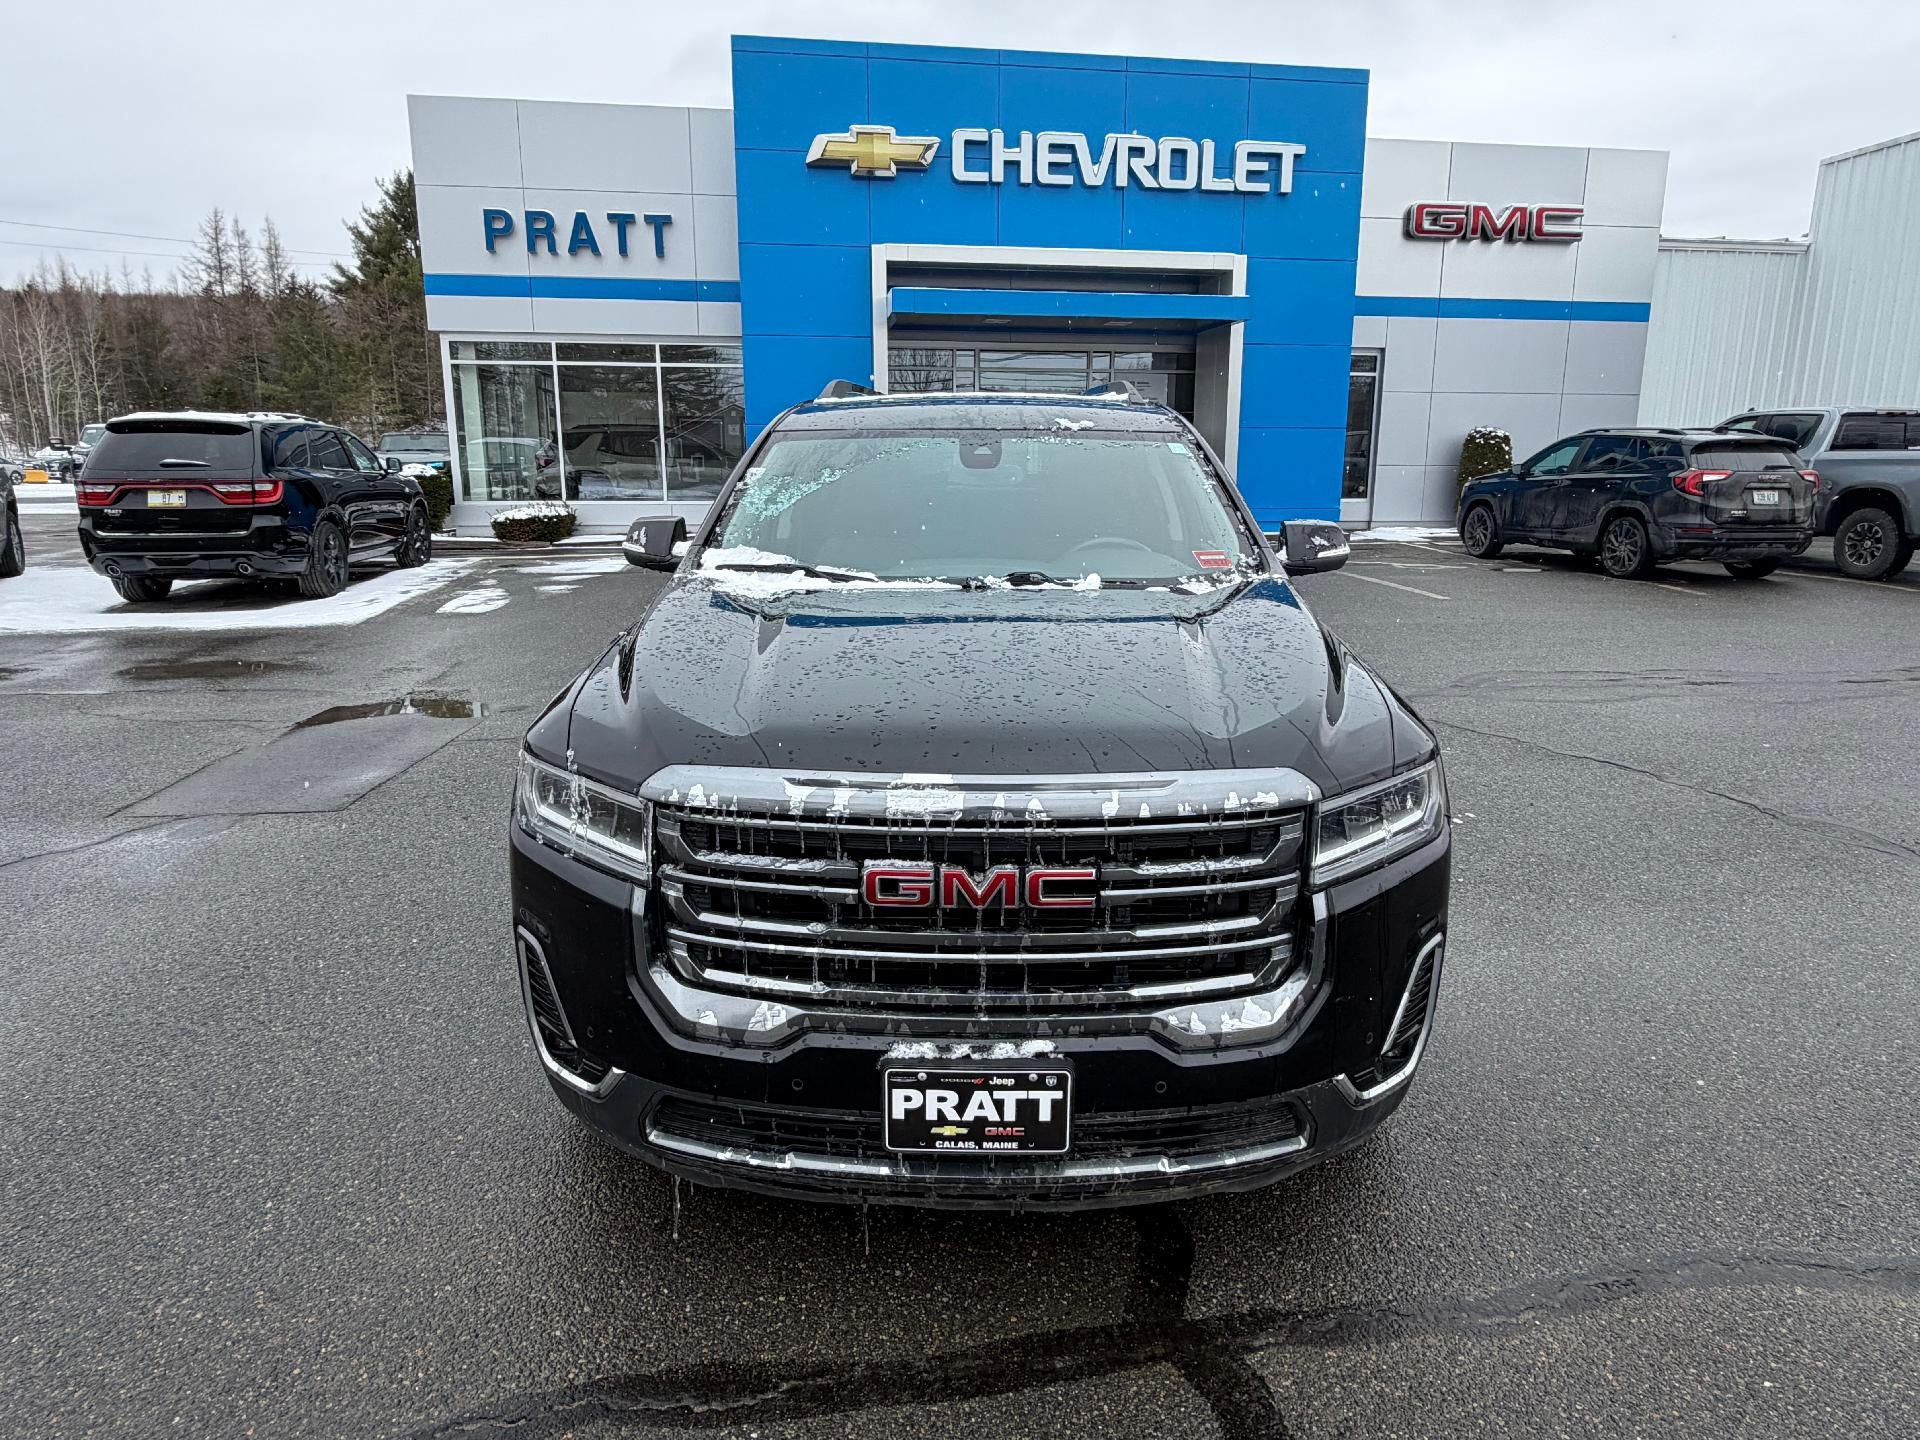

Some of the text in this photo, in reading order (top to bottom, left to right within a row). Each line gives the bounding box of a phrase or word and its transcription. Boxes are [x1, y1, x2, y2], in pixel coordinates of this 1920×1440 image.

[952, 128, 1306, 194] CHEVROLET
[483, 207, 673, 258] PRATT
[1404, 200, 1584, 243] GMC
[863, 866, 1097, 909] GMC
[988, 1076, 1016, 1087] Jeep
[891, 1088, 1064, 1122] PRATT
[935, 1140, 1019, 1150] CALAIS, MAINE
[984, 1126, 1025, 1136] GMC
